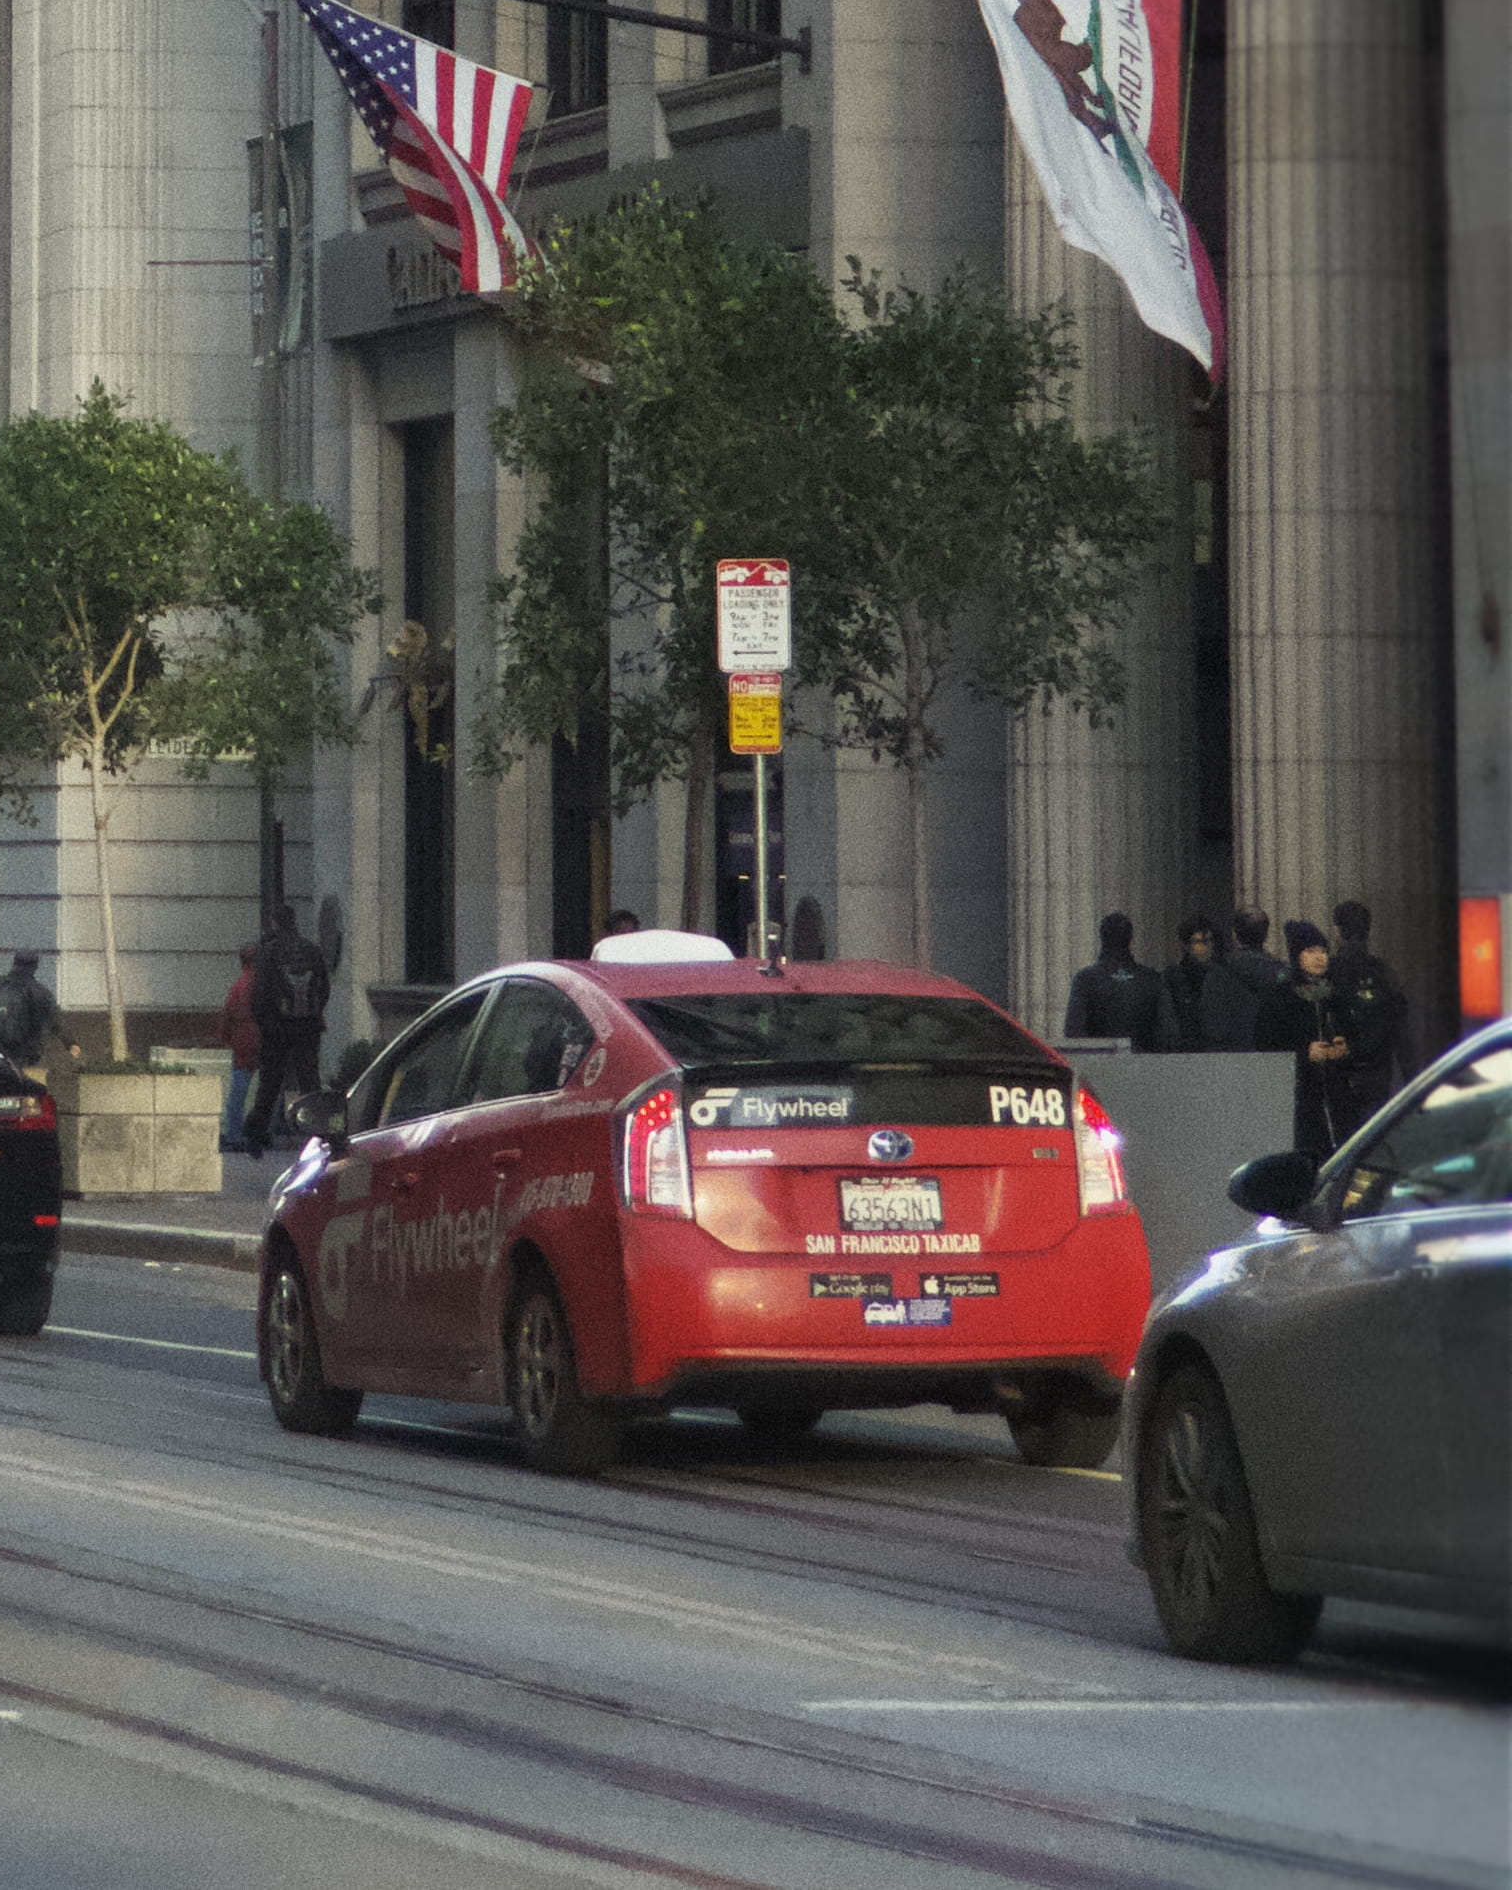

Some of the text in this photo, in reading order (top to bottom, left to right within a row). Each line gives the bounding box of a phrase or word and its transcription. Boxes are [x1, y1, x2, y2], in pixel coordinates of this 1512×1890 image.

[732, 679, 748, 693] NO
[742, 1096, 848, 1121] Flywheel
[989, 1086, 1065, 1126] P648
[805, 1233, 980, 1254] SAN FRANCISCO TAXICAB
[944, 1282, 997, 1297] App Store
